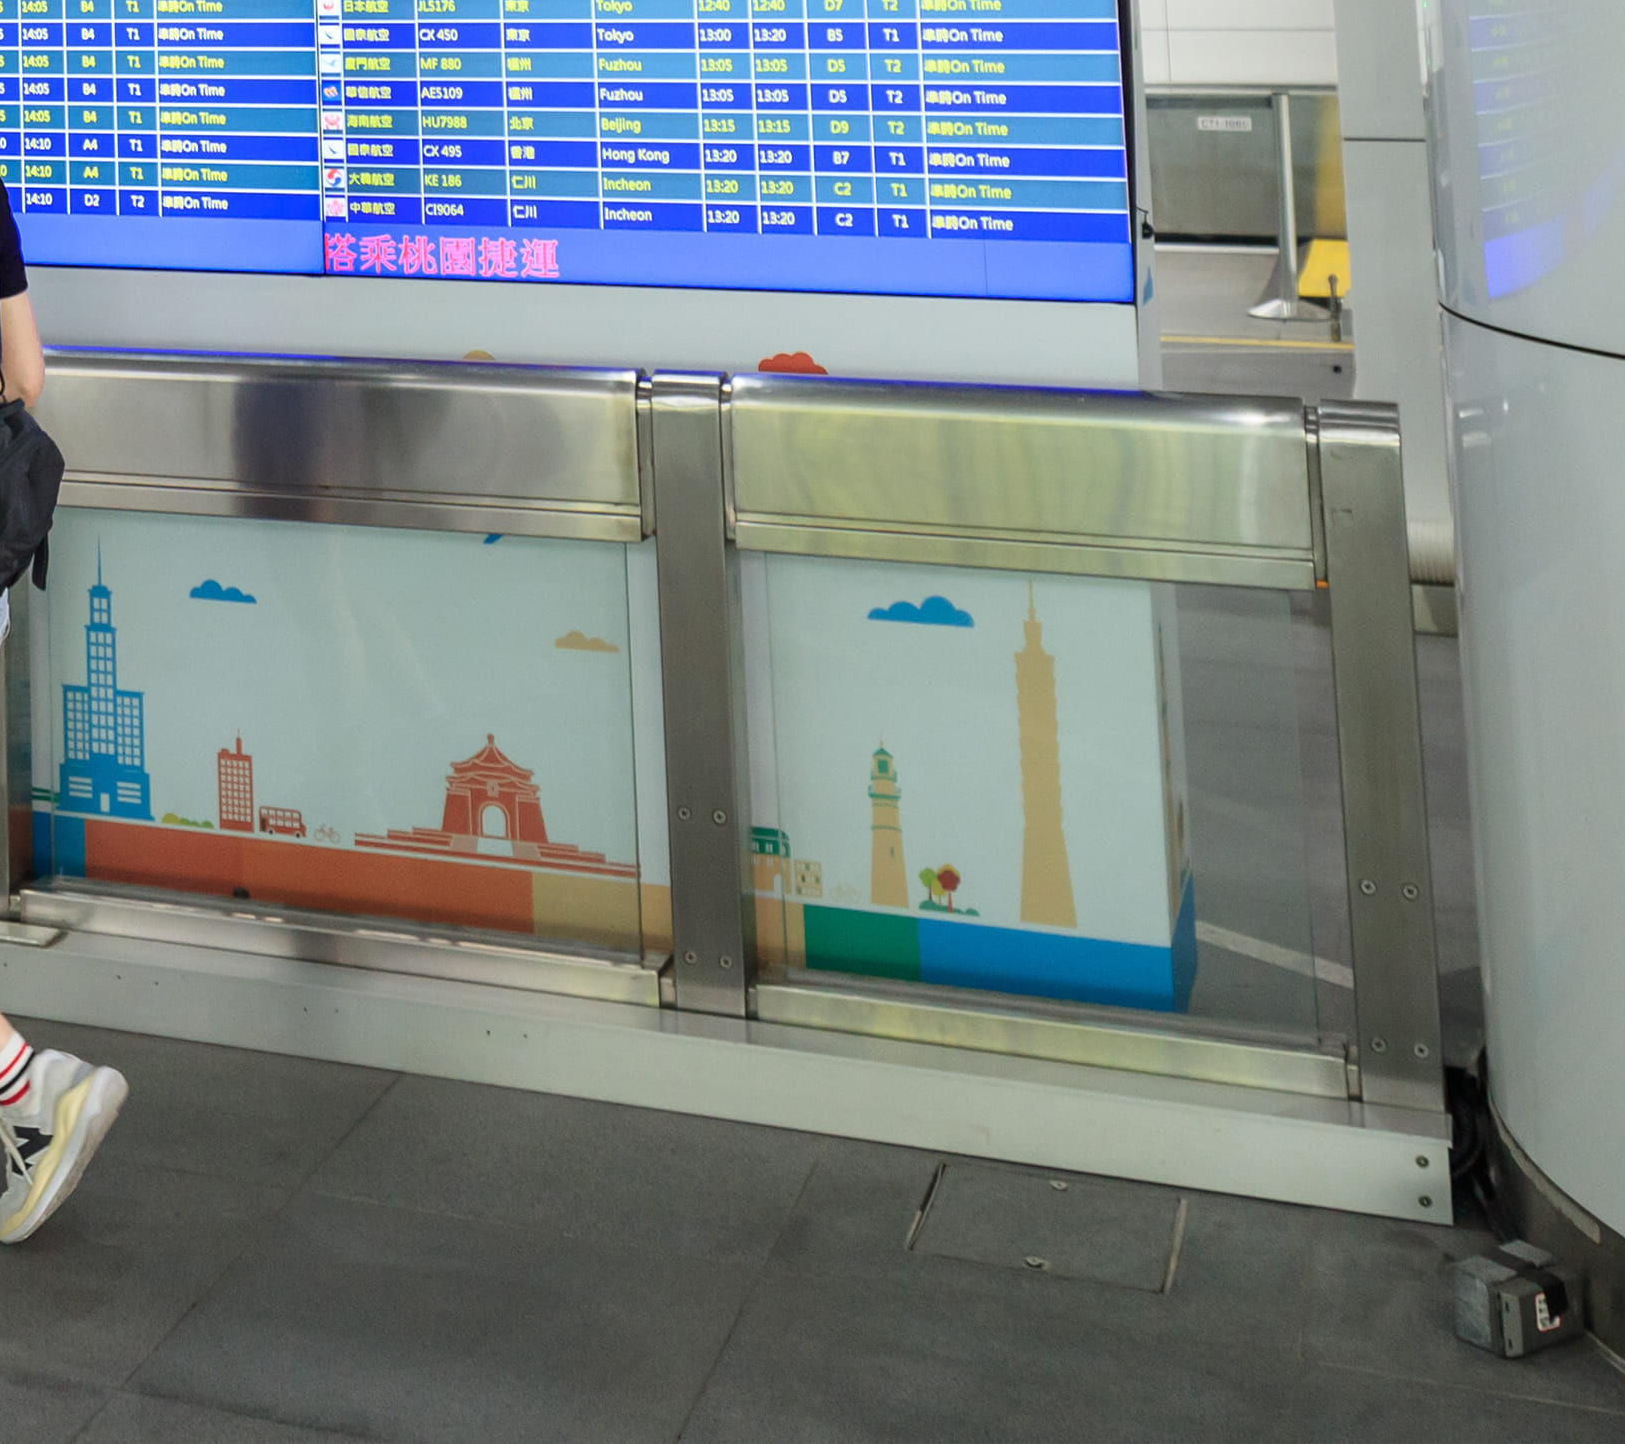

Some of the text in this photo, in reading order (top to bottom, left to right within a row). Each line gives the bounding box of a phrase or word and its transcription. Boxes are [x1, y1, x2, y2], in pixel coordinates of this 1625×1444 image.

[419, 28, 634, 43] CX 450 Tokyo
[421, 57, 642, 72] MF 880 Fuzhou
[421, 86, 643, 102] AE5109 Fuzhou
[422, 116, 467, 129] HU7988
[600, 118, 642, 133] Beijing
[425, 173, 652, 191] KE 186 Incheon
